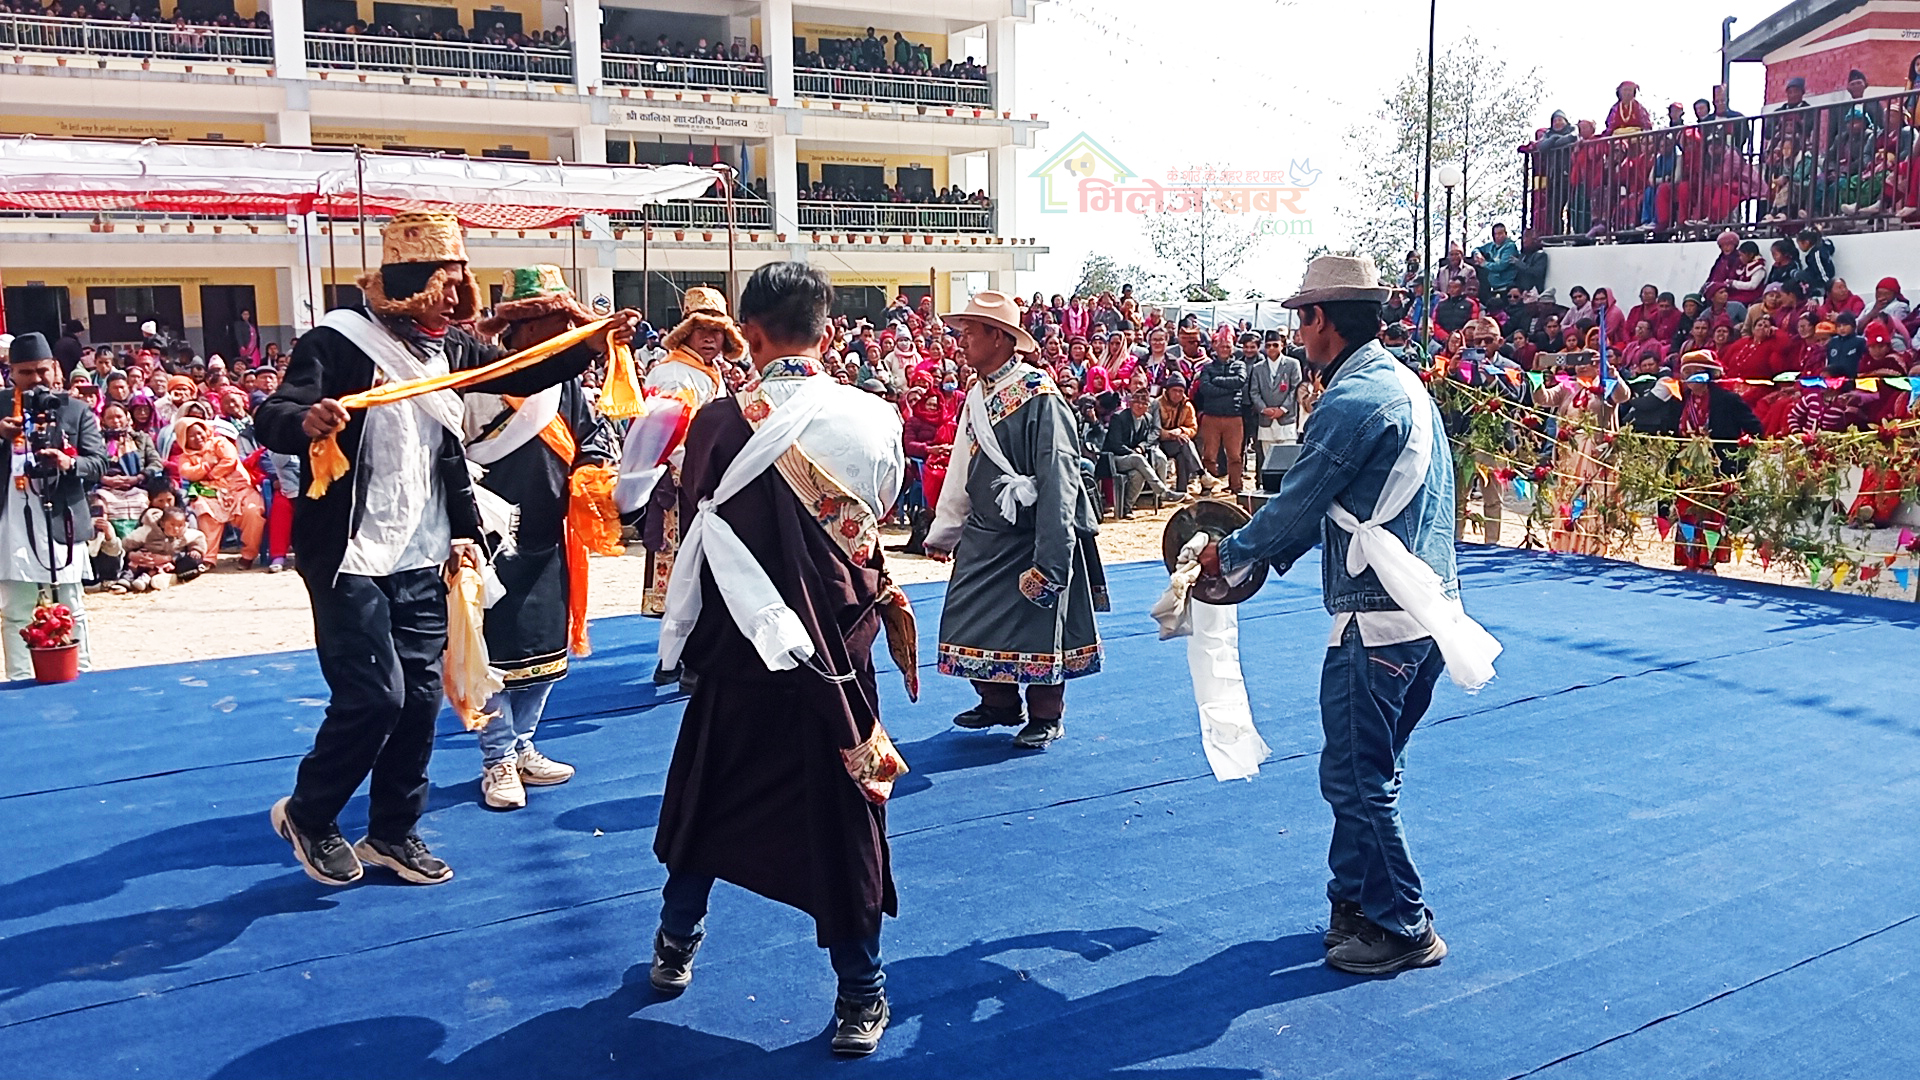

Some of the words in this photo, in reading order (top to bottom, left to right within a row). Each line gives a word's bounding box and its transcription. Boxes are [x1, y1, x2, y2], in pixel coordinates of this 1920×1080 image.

[626, 110, 637, 120] श्री
[639, 112, 671, 122] कालिका
[673, 114, 714, 125] माध्यमिक
[716, 116, 748, 127] विद्यालय
